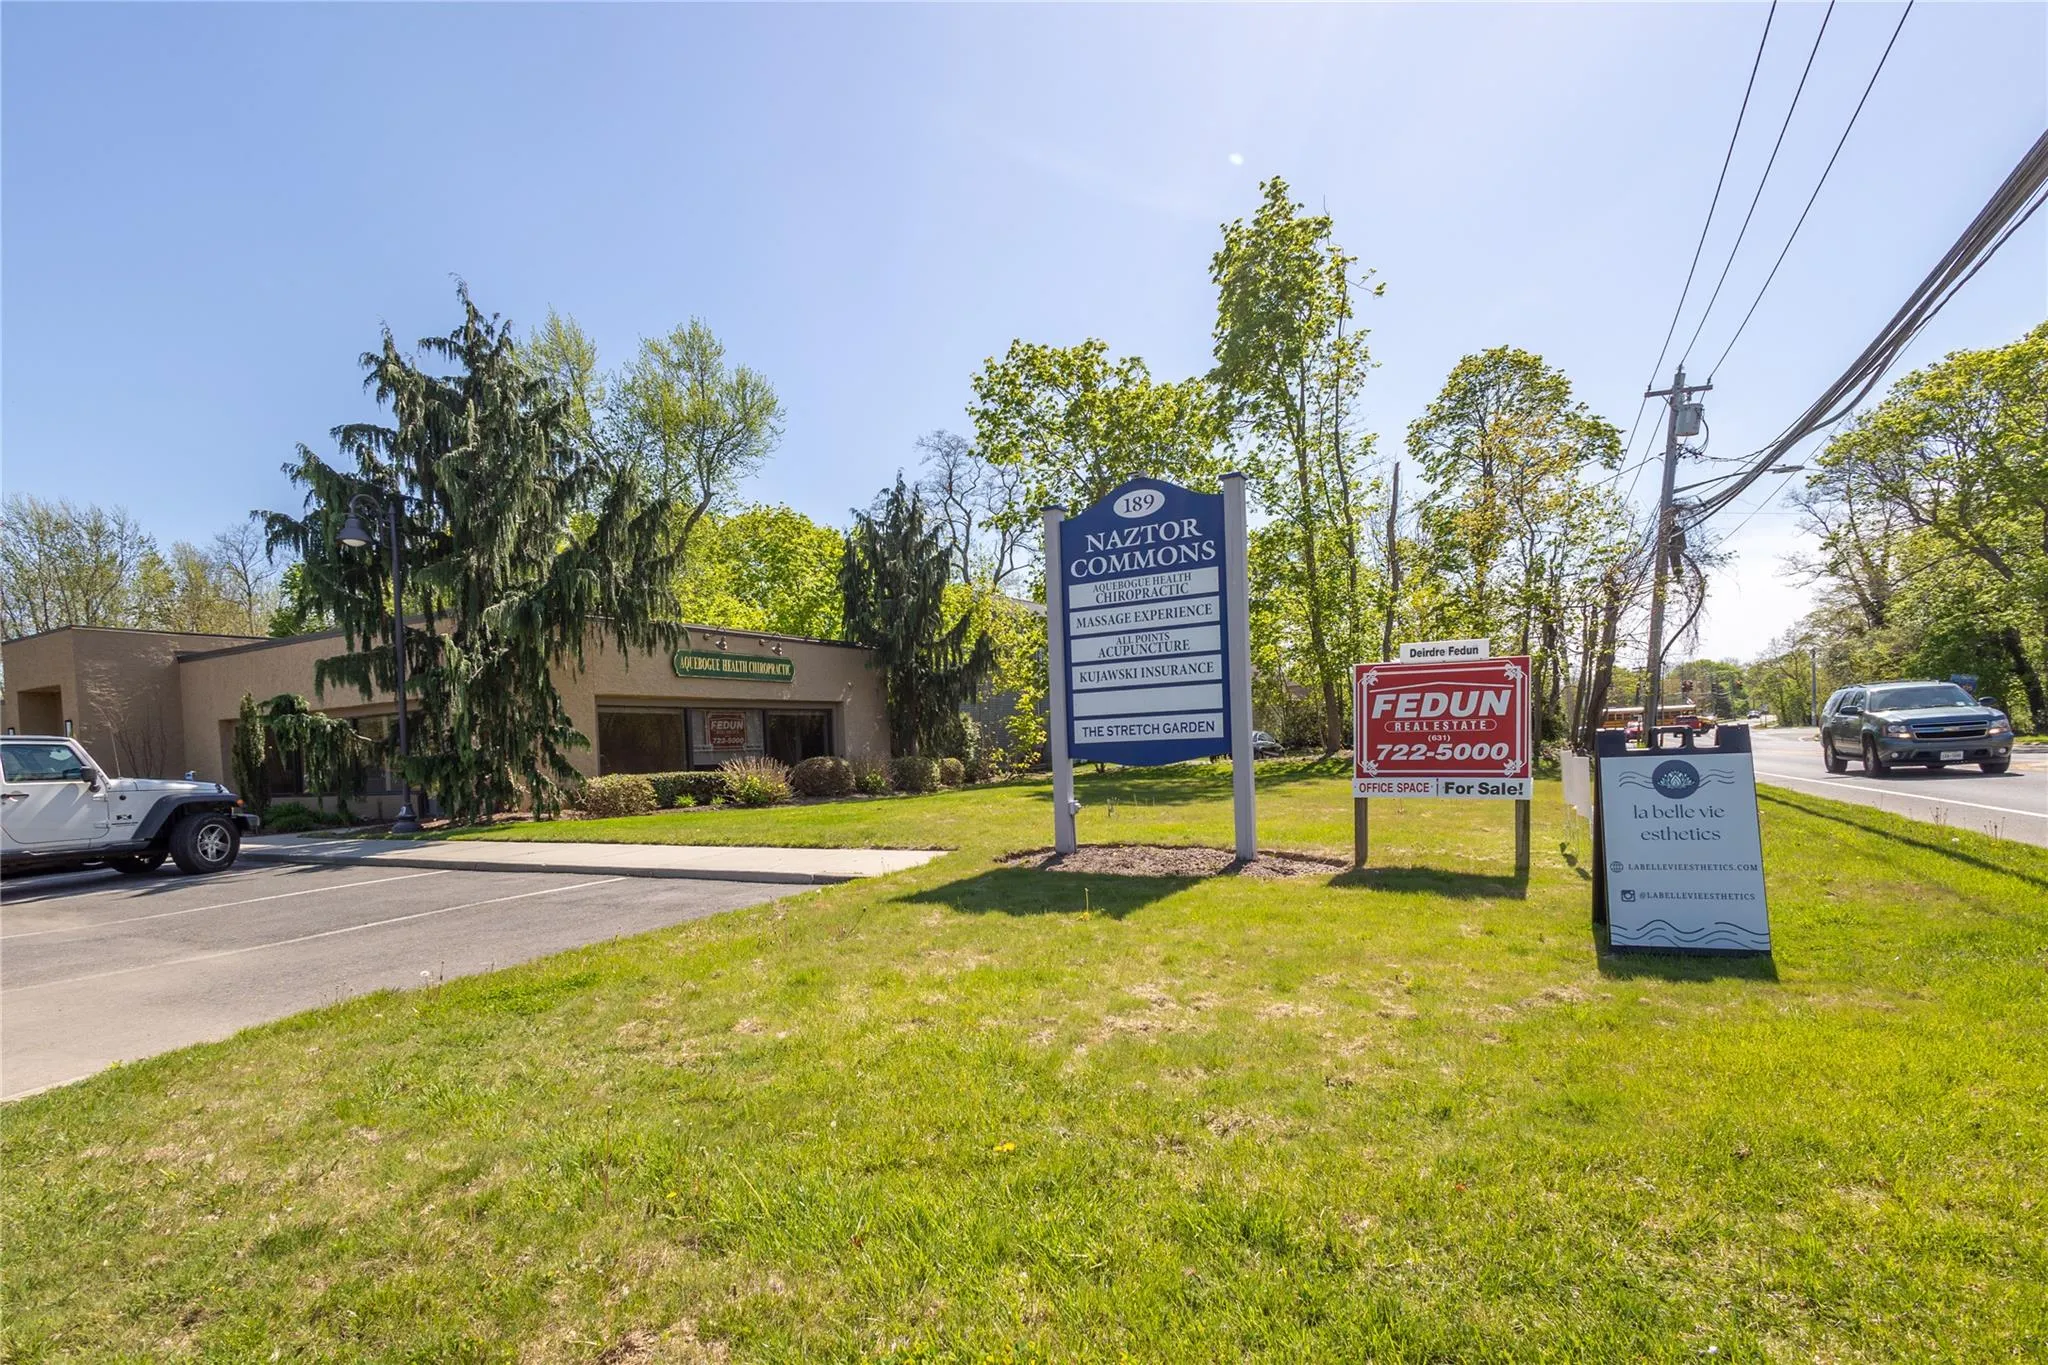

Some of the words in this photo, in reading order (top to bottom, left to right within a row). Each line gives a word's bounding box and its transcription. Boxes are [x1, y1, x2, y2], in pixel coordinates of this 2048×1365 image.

[1123, 494, 1155, 513] 189
[1085, 518, 1202, 553] NAZTOR
[1070, 540, 1216, 577] COMMONS
[1093, 577, 1151, 593] AQUEBOGUE
[1153, 572, 1191, 585] HEALTH
[1095, 583, 1189, 603] CHIROPRACTIC
[1076, 613, 1131, 628] MASSAGE
[1135, 603, 1212, 622] EXPERIENCE
[1116, 635, 1133, 645] ALL
[1136, 632, 1170, 643] POINTS
[1099, 640, 1190, 658] ACUPUNCTURE
[1410, 648, 1445, 658] Deirdre
[1448, 646, 1479, 656] Fedun
[680, 656, 720, 672] AQUEBOGUE
[722, 660, 747, 672] HEALTH
[749, 662, 791, 675] CHIROPRACTIC
[1080, 668, 1137, 683] KUJAWSKI
[1141, 662, 1214, 678] INSURANCE
[1372, 690, 1511, 718] FEDUN
[711, 721, 744, 730] FEDUN
[1082, 726, 1104, 737] THE
[1107, 724, 1160, 736] STRETCH
[1163, 721, 1215, 733] GARDEN
[1395, 722, 1429, 731] REAL
[1434, 721, 1486, 730] ESTATE
[1376, 743, 1509, 760] 722-5000
[1359, 783, 1393, 792] OFFICE
[1397, 783, 1429, 792] SPACE
[1444, 782, 1474, 794] For
[1478, 783, 1523, 795] Sale!
[1634, 805, 1648, 819] la
[1653, 804, 1695, 819] belle
[1699, 806, 1725, 818] vie
[1641, 827, 1721, 841] esthetics
[1639, 892, 1755, 900] @LABELLEVIEESTHETICS
